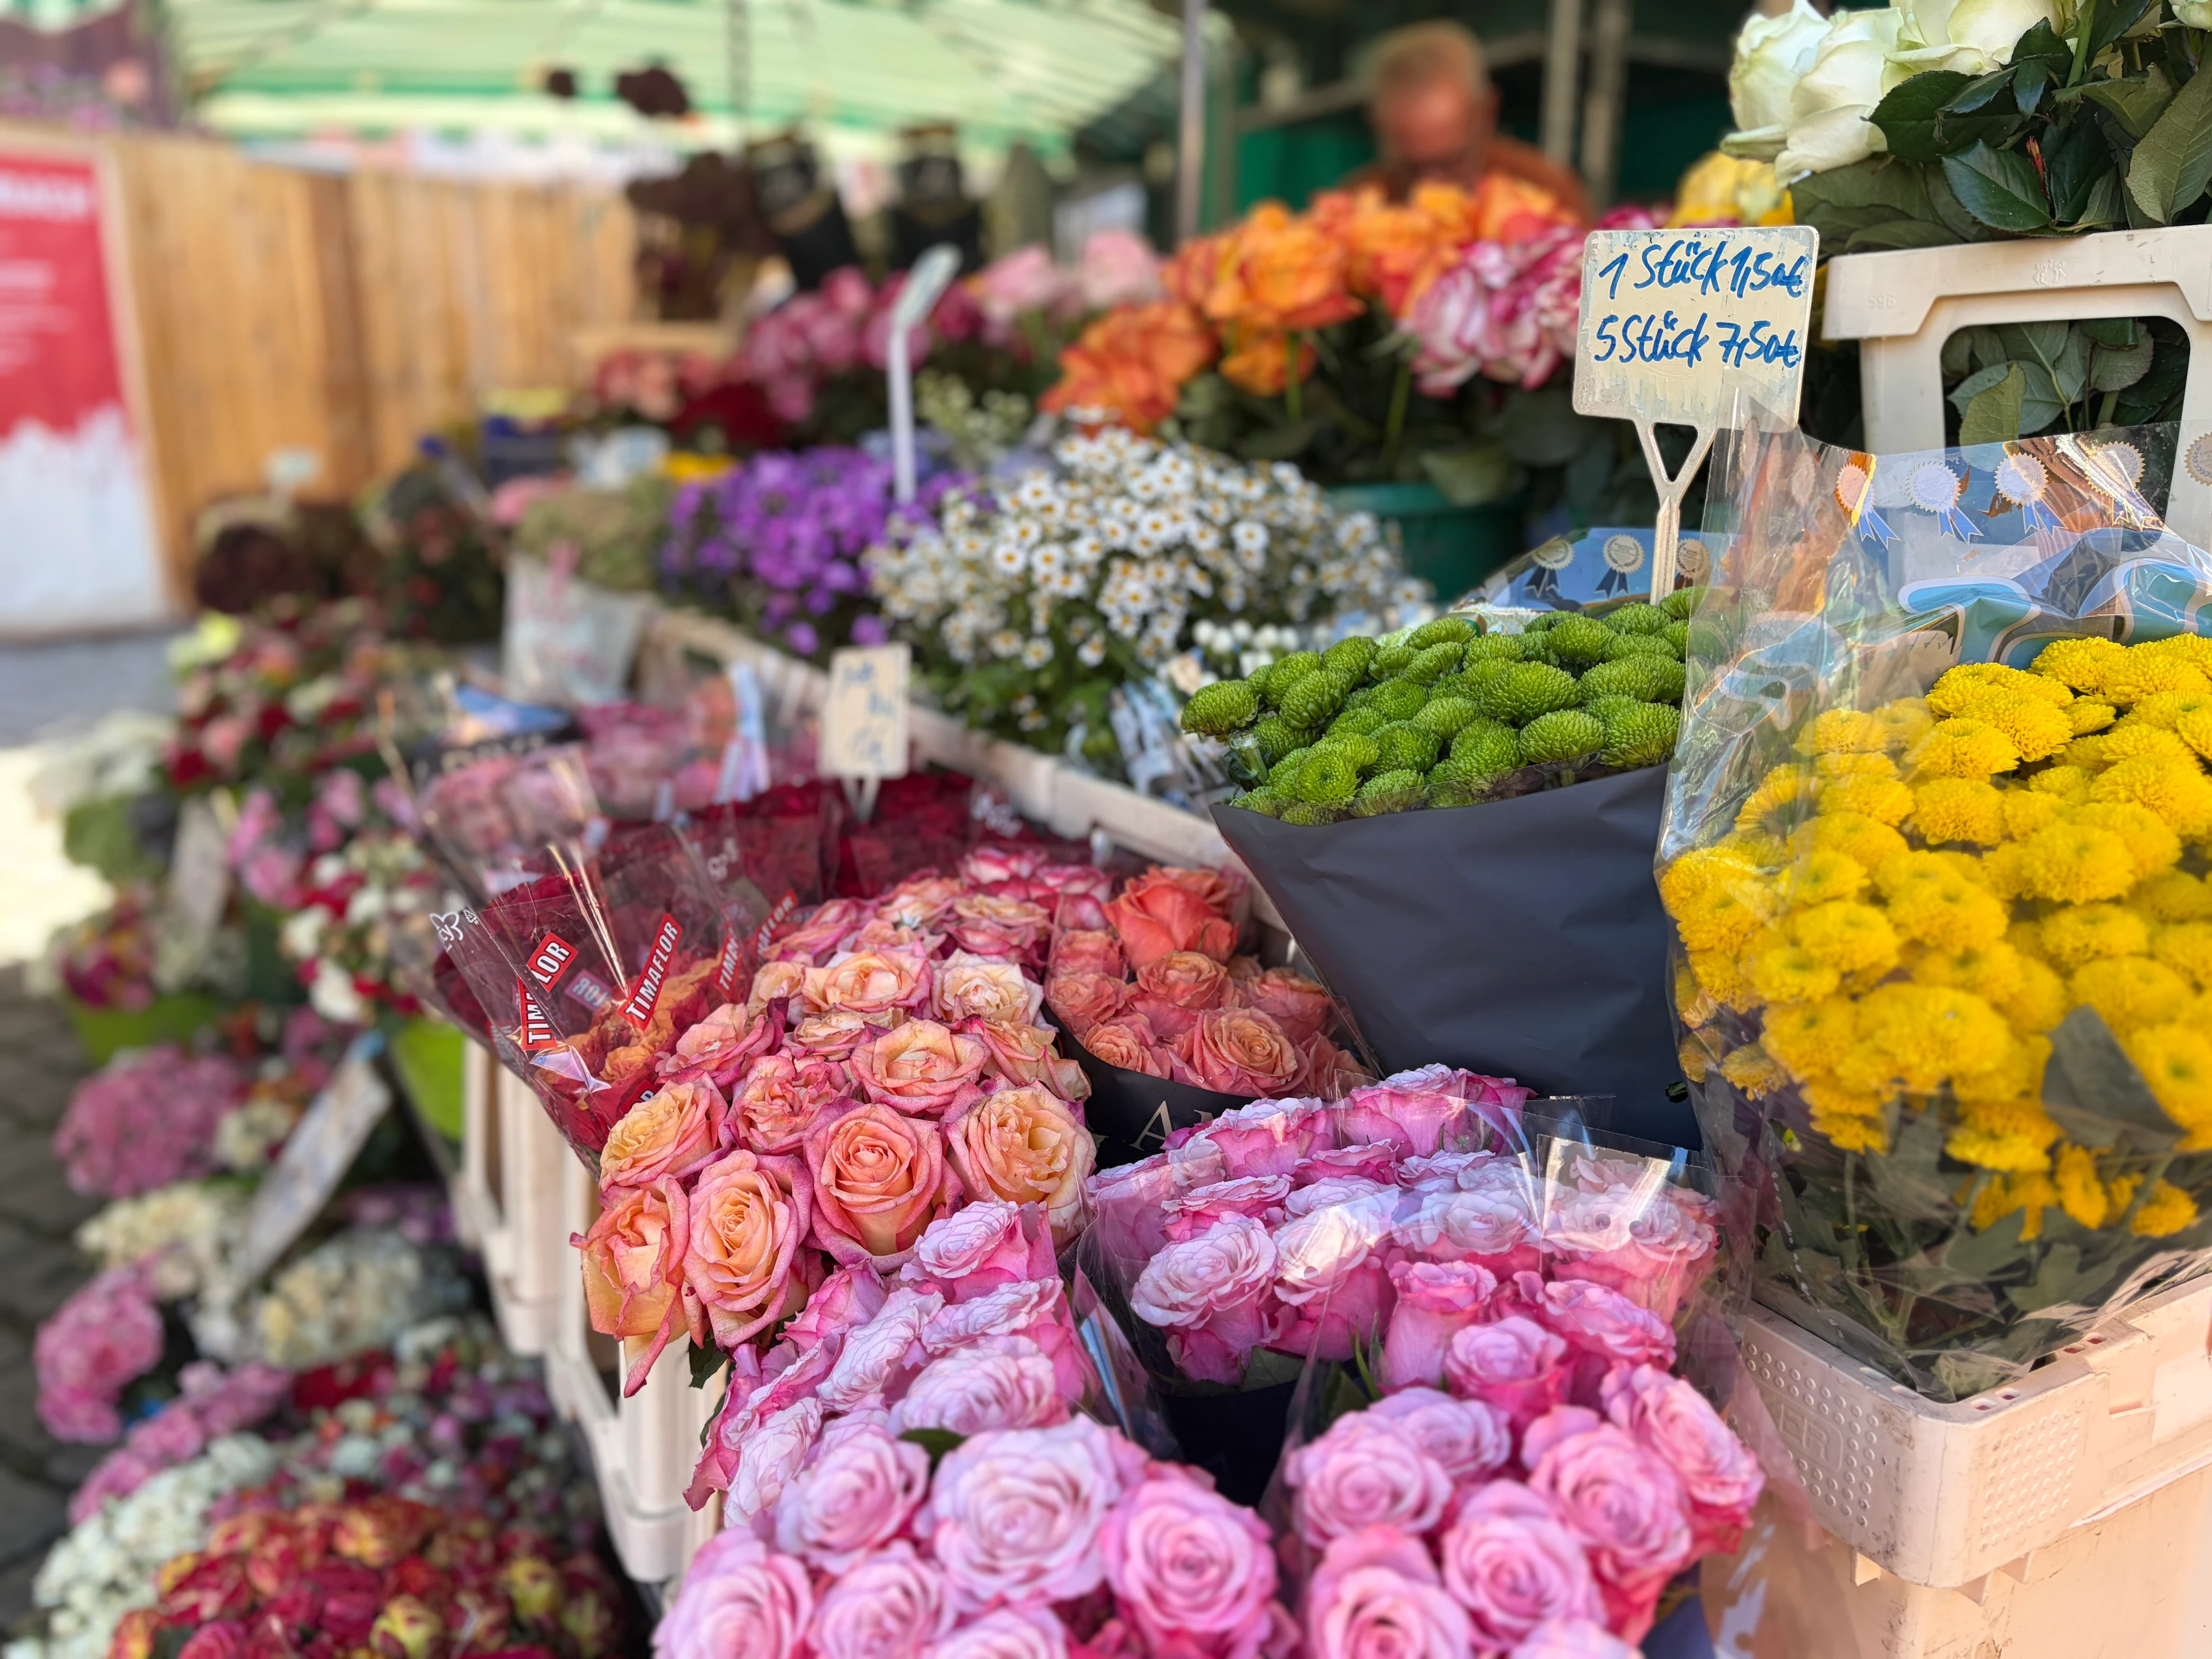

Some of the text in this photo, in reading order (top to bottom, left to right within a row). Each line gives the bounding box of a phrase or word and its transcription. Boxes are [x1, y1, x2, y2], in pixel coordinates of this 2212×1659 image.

[1599, 253, 1628, 300] 1
[1634, 240, 1728, 296] Stück
[625, 921, 678, 1021] TIMAFLOR
